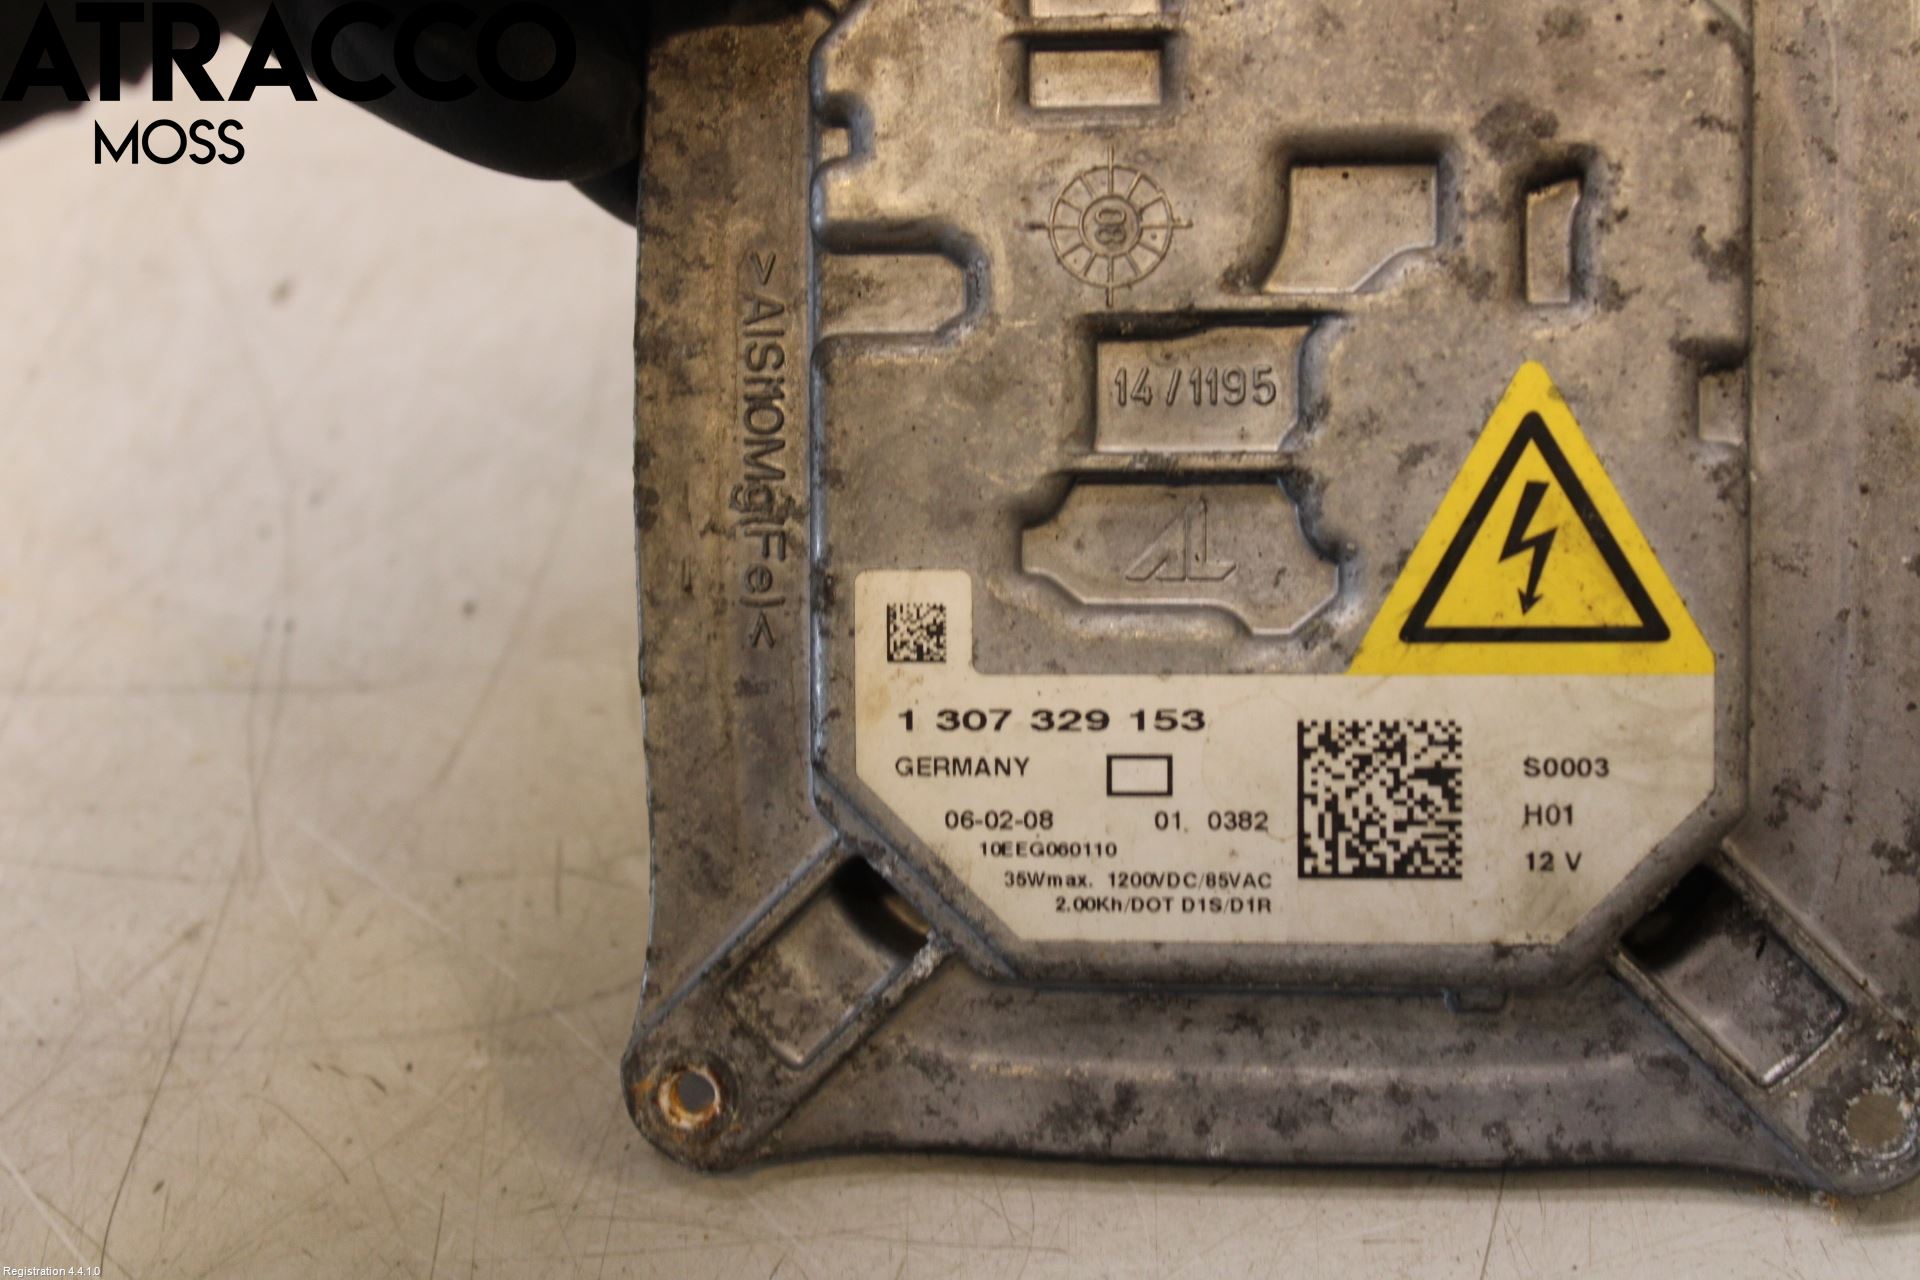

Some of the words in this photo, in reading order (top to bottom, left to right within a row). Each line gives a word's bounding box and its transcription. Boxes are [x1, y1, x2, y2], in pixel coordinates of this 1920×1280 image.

[899, 709, 914, 732] 1
[936, 708, 1012, 732] 307
[1030, 708, 1109, 732] 329
[1131, 708, 1206, 732] 153
[895, 756, 1030, 777] GERMANY
[1523, 756, 1610, 777] S0003
[944, 810, 1054, 831] 06-02-08
[1207, 810, 1269, 831] 0382
[1523, 803, 1573, 826] H01
[1526, 851, 1554, 872] 12
[1564, 851, 1582, 872] V
[1108, 871, 1272, 889] 1200VDC/85VAC
[1055, 896, 1174, 913] 2.00Kh/DOT
[1182, 896, 1272, 913] D1S/D1R
